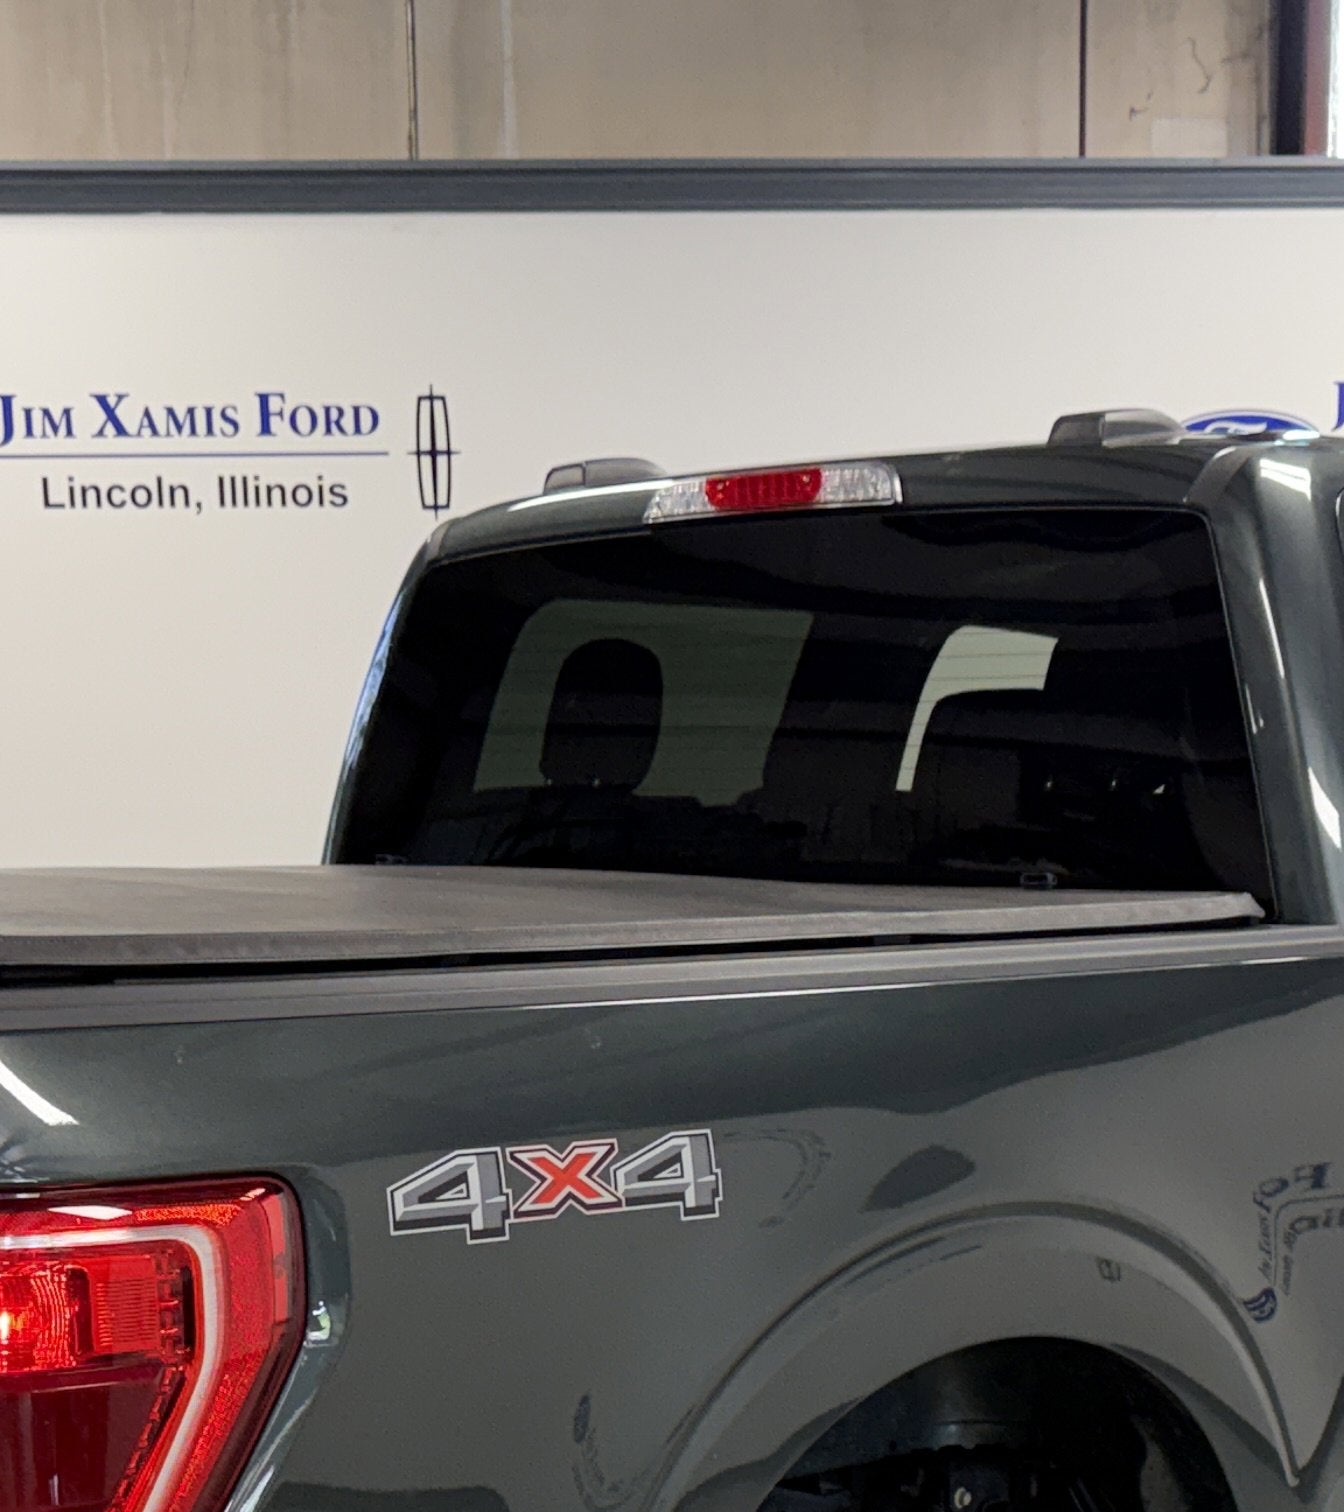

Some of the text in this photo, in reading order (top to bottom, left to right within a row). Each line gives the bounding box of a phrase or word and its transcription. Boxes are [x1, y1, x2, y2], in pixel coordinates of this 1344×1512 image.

[89, 392, 241, 438] XAMIS
[254, 391, 381, 437] FORD
[41, 475, 349, 515] Lincoln, Illinois
